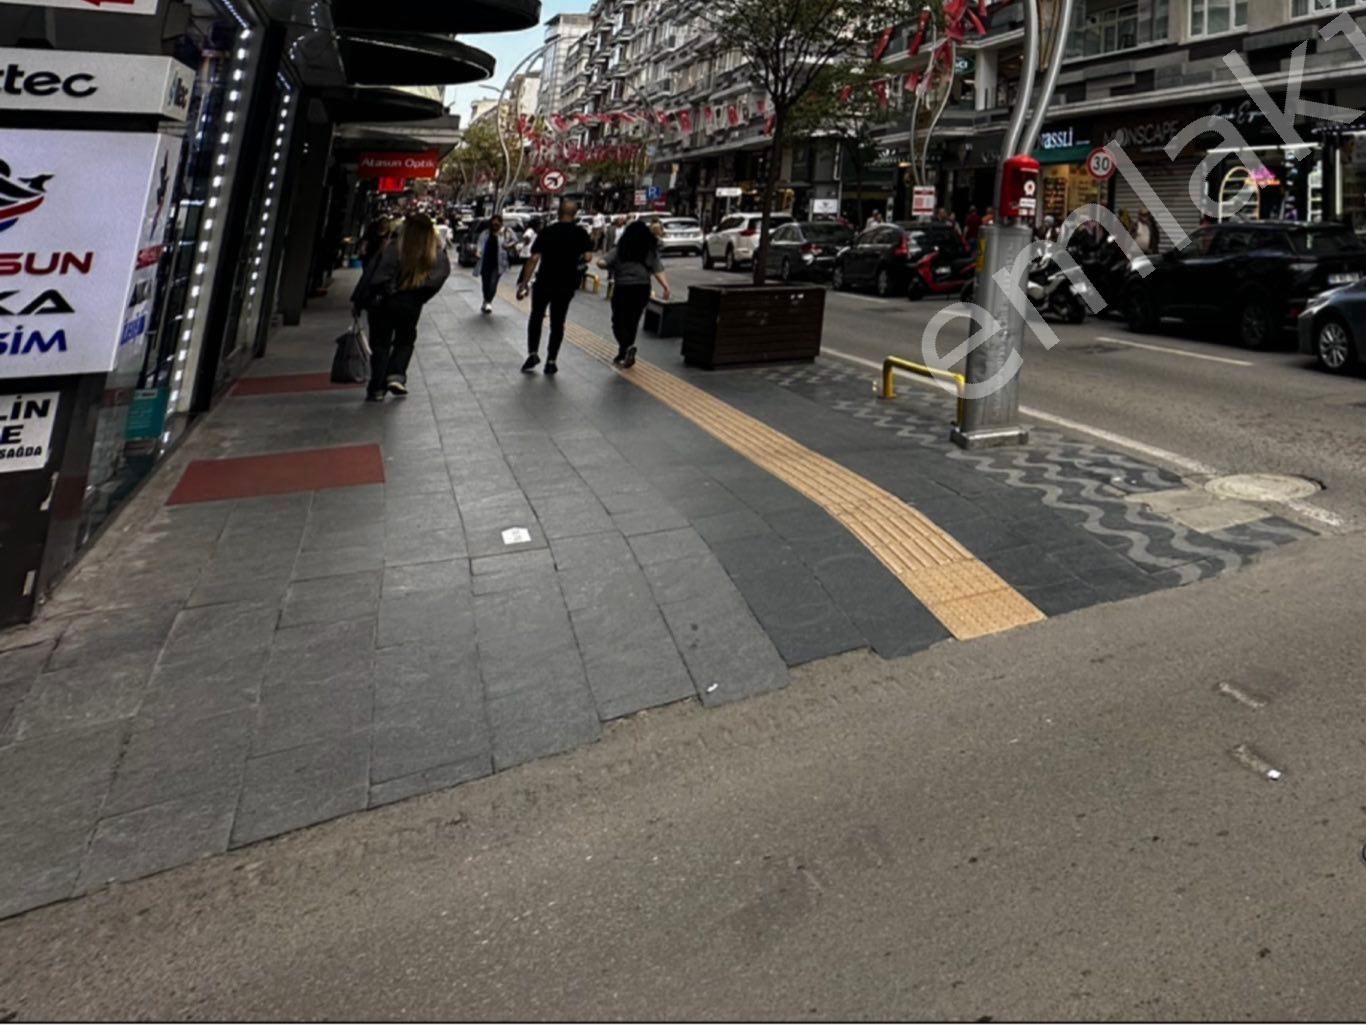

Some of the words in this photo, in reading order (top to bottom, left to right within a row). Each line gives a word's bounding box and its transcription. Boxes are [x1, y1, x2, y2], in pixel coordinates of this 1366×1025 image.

[0, 64, 98, 97] tec
[361, 158, 401, 168] Atasun
[404, 158, 435, 169] Optik
[1093, 156, 1110, 171] 30
[0, 252, 93, 275] SUN
[0, 395, 51, 421] İN
